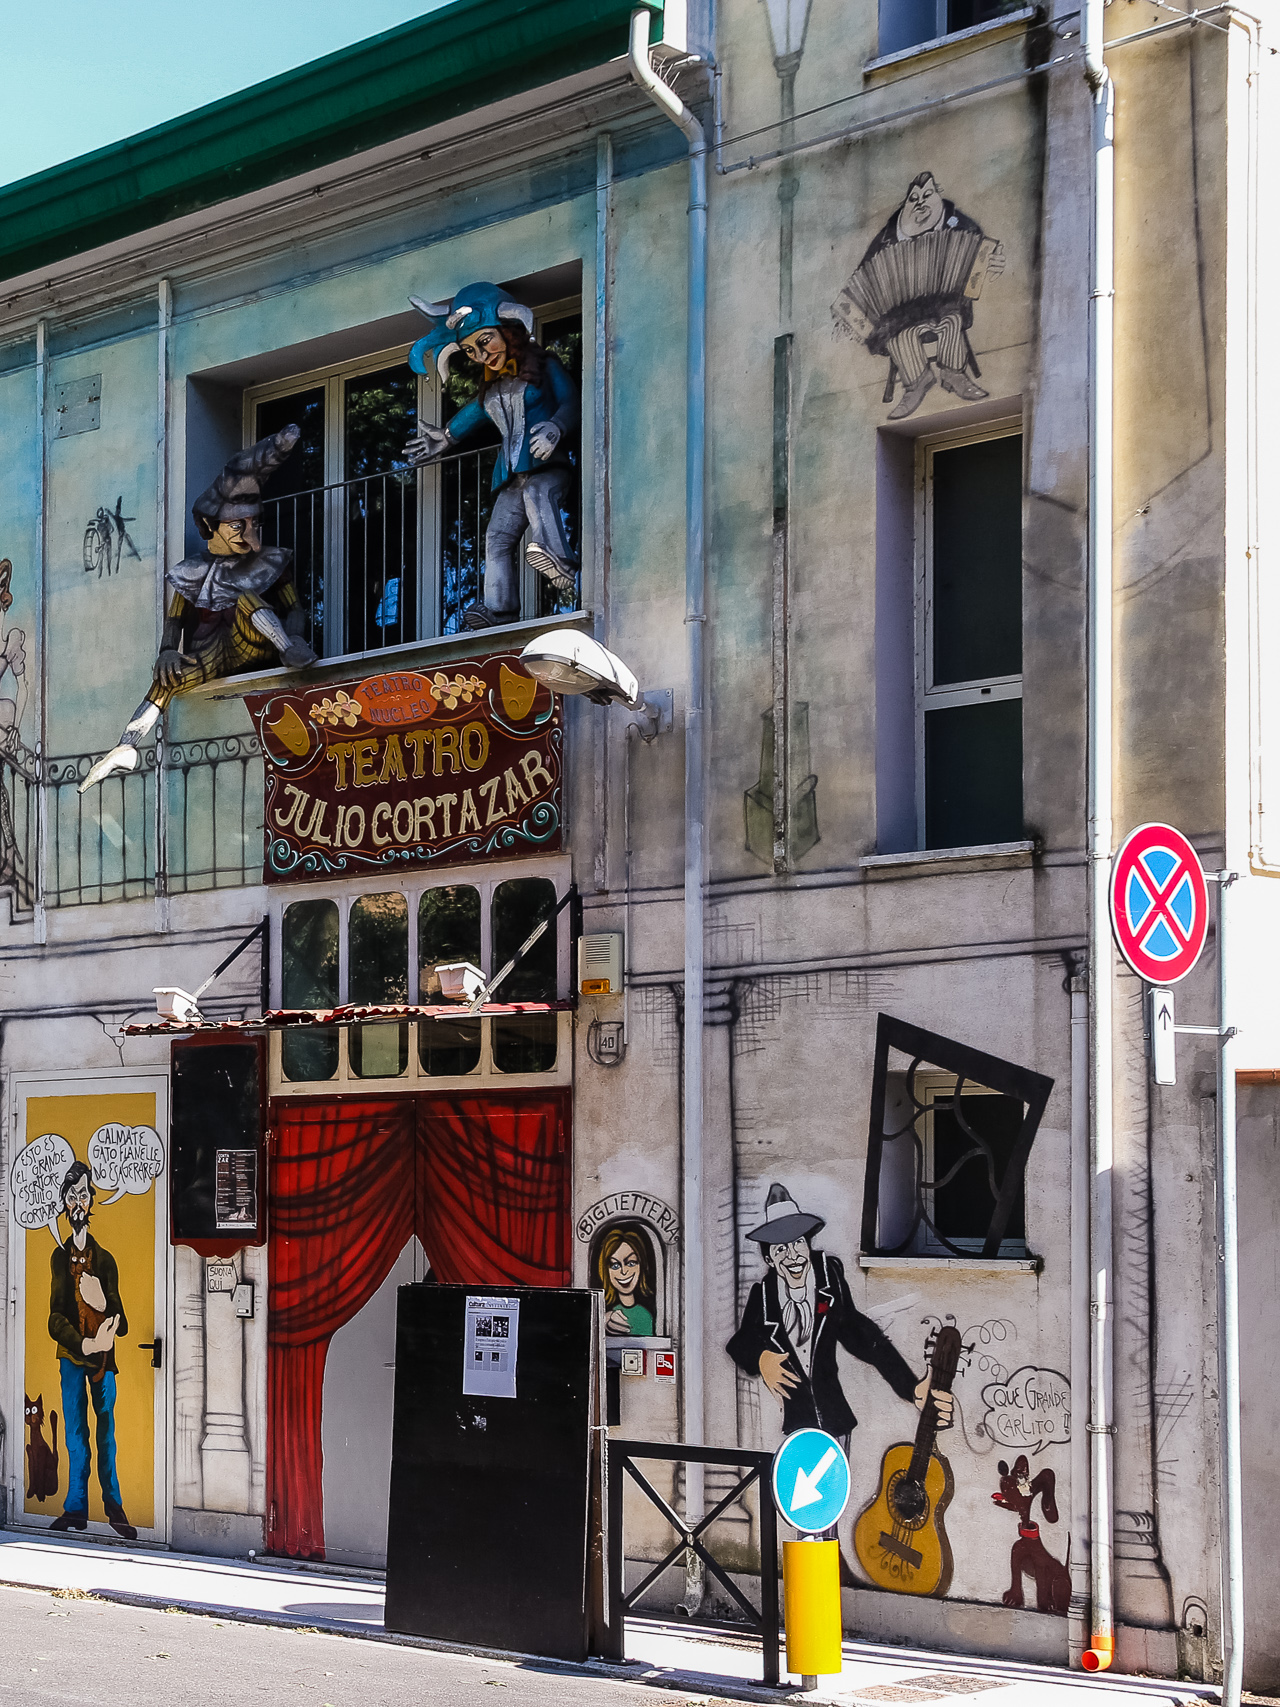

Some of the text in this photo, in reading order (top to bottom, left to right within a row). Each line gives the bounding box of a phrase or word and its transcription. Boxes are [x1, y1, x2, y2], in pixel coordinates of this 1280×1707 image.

[361, 676, 423, 700] TEATRO
[369, 699, 431, 723] NUCLEO
[326, 721, 490, 792] TEATRO
[274, 749, 554, 847] JULIO CORTAZAR
[601, 1037, 614, 1048] 40
[98, 1128, 148, 1146] CALMATE
[21, 1134, 55, 1166] ESTO ES
[93, 1145, 117, 1163] GATO
[16, 1149, 67, 1184] EL GRANDE
[93, 1163, 106, 1180] NO
[29, 1190, 53, 1206] JULIO
[20, 1201, 60, 1224] CORTAZAR
[579, 1193, 680, 1242] BIGLIETTERIA
[209, 1266, 232, 1277] SUONA
[993, 1377, 1070, 1413] QUE GRANDE
[997, 1413, 1055, 1440] CARLITO
